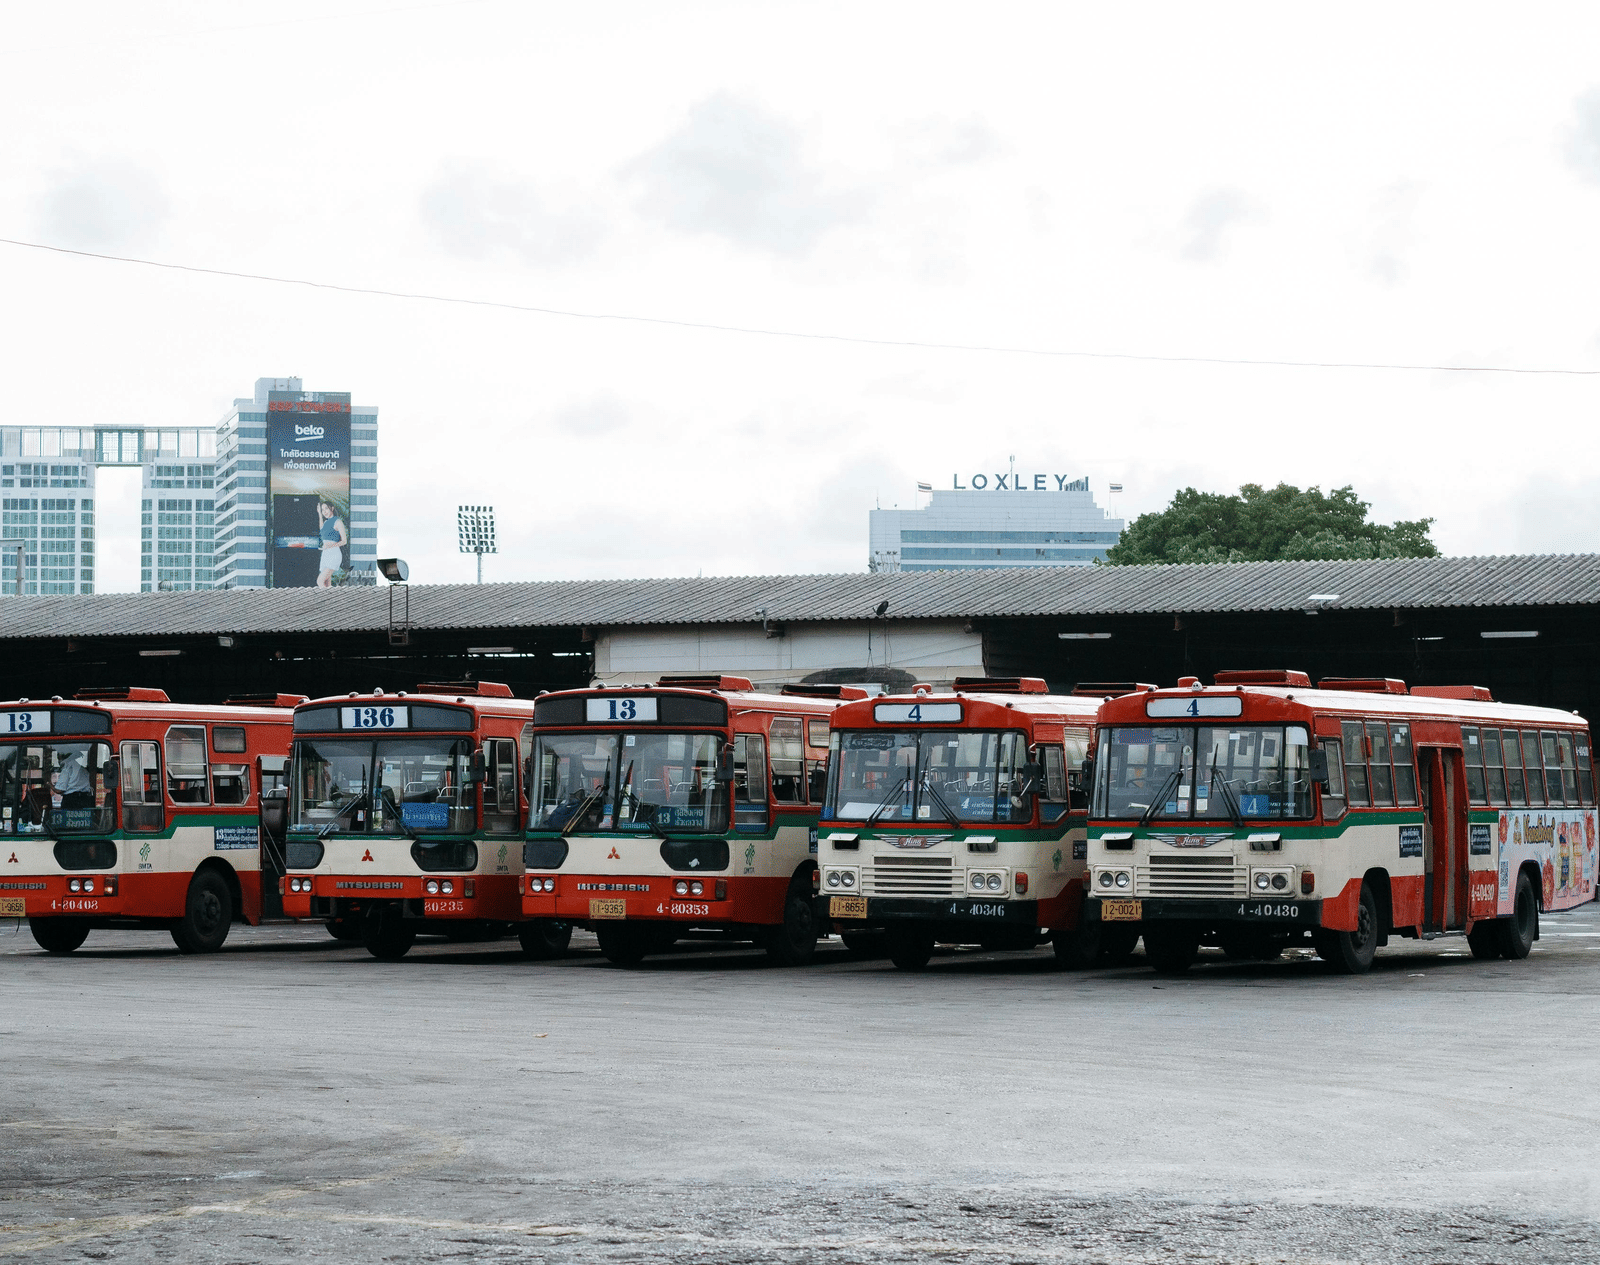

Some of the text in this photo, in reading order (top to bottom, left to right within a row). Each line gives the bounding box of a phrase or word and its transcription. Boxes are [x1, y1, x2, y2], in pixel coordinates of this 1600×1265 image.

[295, 424, 325, 435] beko
[953, 473, 1068, 491] LOXLEY
[607, 699, 636, 720] 13
[907, 704, 922, 722] 4
[1186, 699, 1200, 717] 4
[8, 713, 33, 733] 13
[352, 708, 395, 728] 136
[961, 797, 970, 809] 4
[1247, 798, 1258, 815] 4
[51, 814, 63, 825] 13
[657, 812, 671, 824] 13
[216, 829, 224, 840] 13
[335, 881, 404, 889] MITSUBISHI
[577, 883, 650, 892] MITSUBISHI
[833, 902, 865, 912] 11-8653
[1105, 904, 1138, 915] 12-0021
